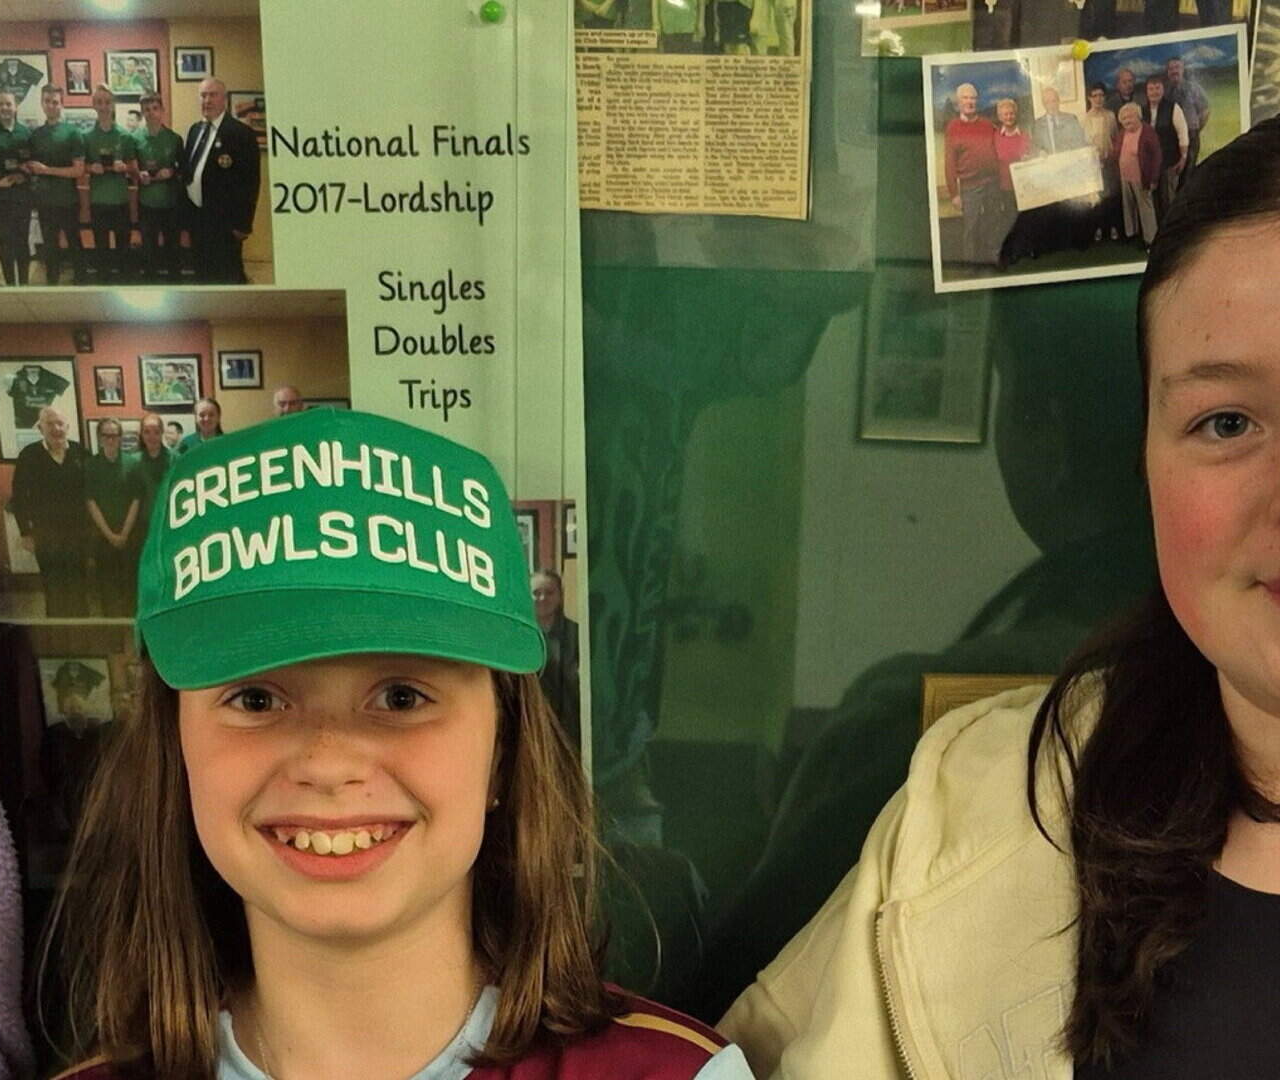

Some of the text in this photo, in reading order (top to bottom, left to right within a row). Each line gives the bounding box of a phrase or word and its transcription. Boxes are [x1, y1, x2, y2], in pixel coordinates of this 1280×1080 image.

[270, 123, 531, 158] National Finals
[274, 180, 494, 226] 2017-Lordship
[378, 269, 486, 315] Singles
[374, 324, 495, 356] Doubles
[399, 380, 472, 422] Trips
[169, 440, 492, 529] GREENHILLS
[174, 510, 496, 601] BOWLS CLUB
